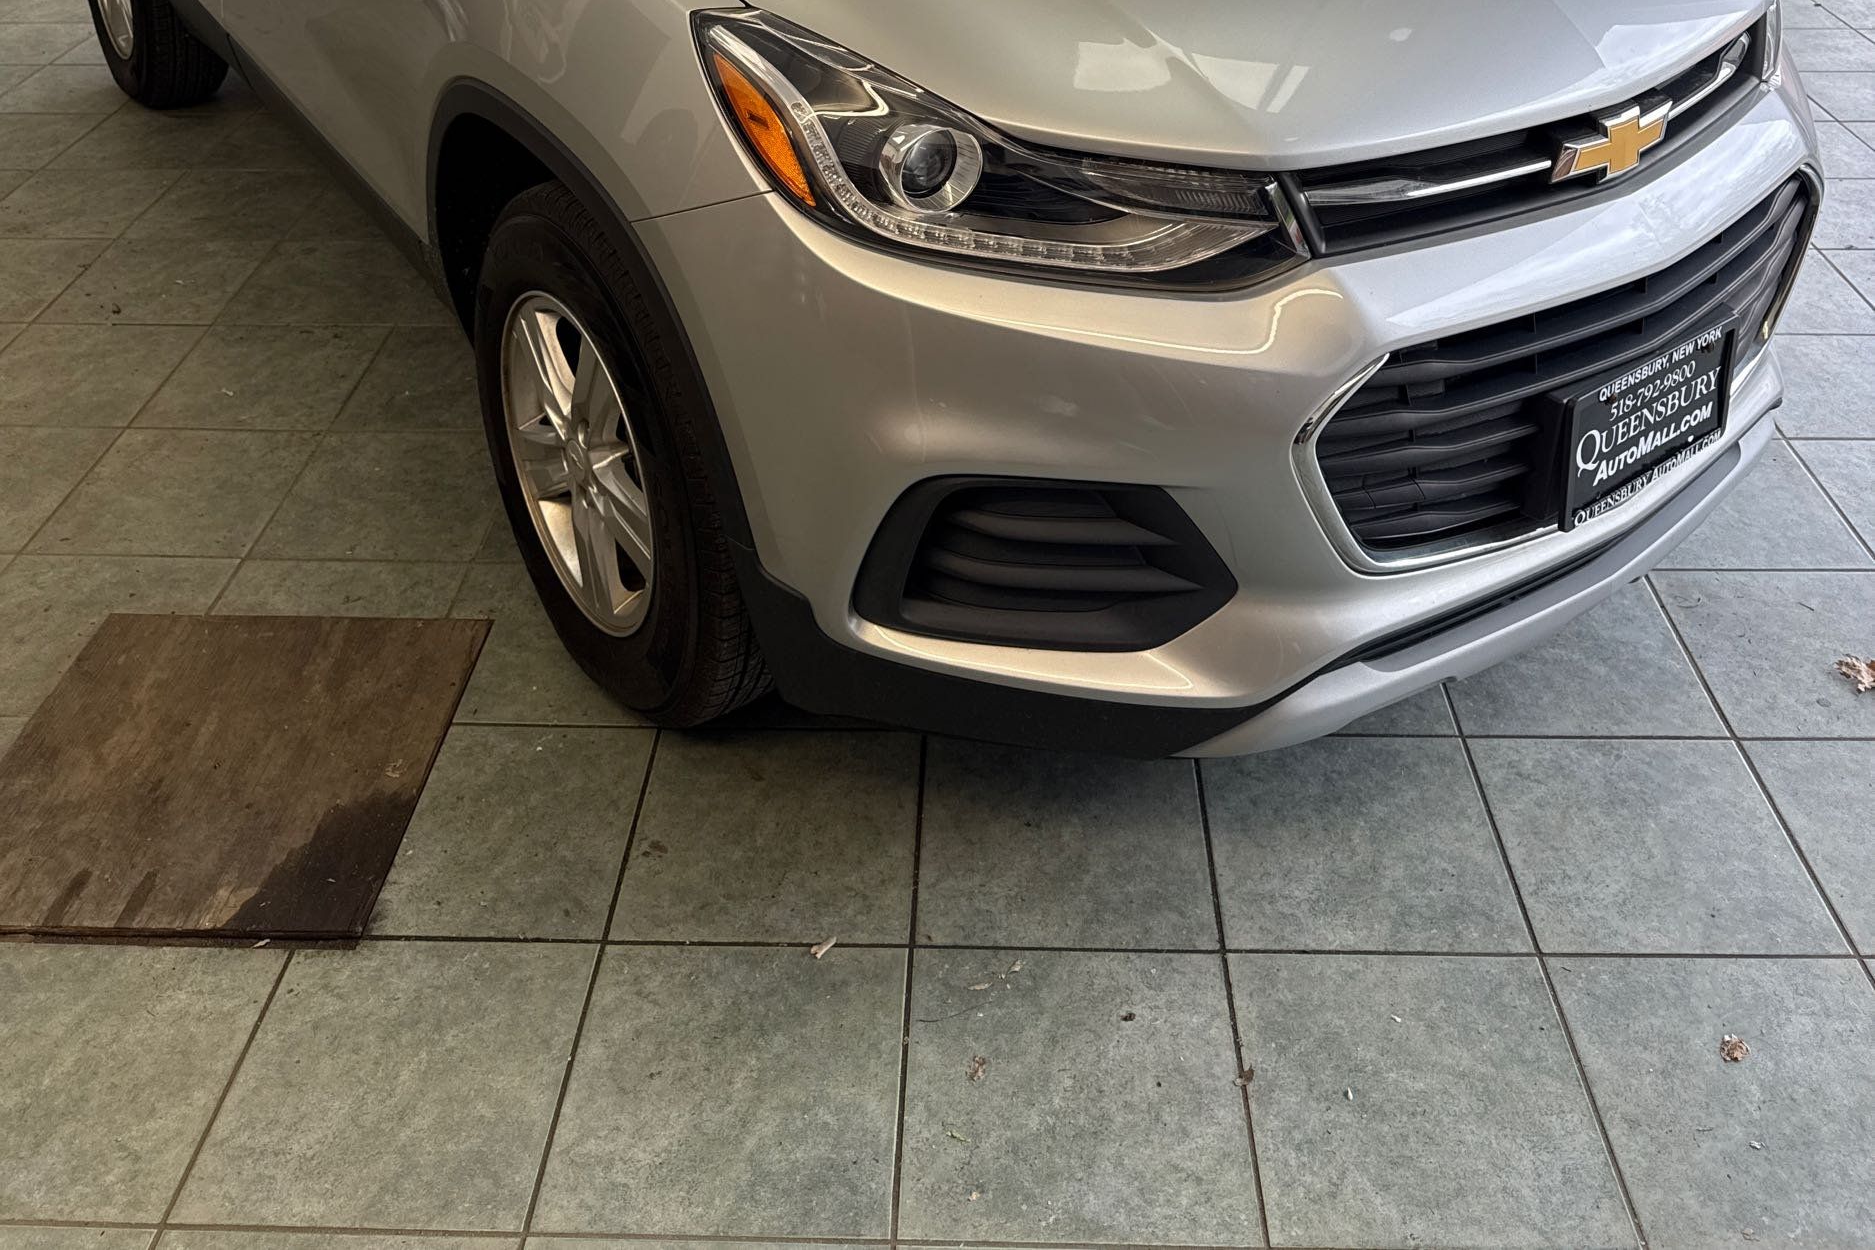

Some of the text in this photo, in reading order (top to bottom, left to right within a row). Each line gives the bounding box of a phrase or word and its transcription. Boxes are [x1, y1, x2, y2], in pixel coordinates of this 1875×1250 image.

[1599, 326, 1723, 401] QUEENSBURY, NEW YORK
[1609, 360, 1696, 421] 518-792-9800
[1576, 366, 1721, 478] QUEENSBURY
[1574, 475, 1650, 527] QUEENSBURY
